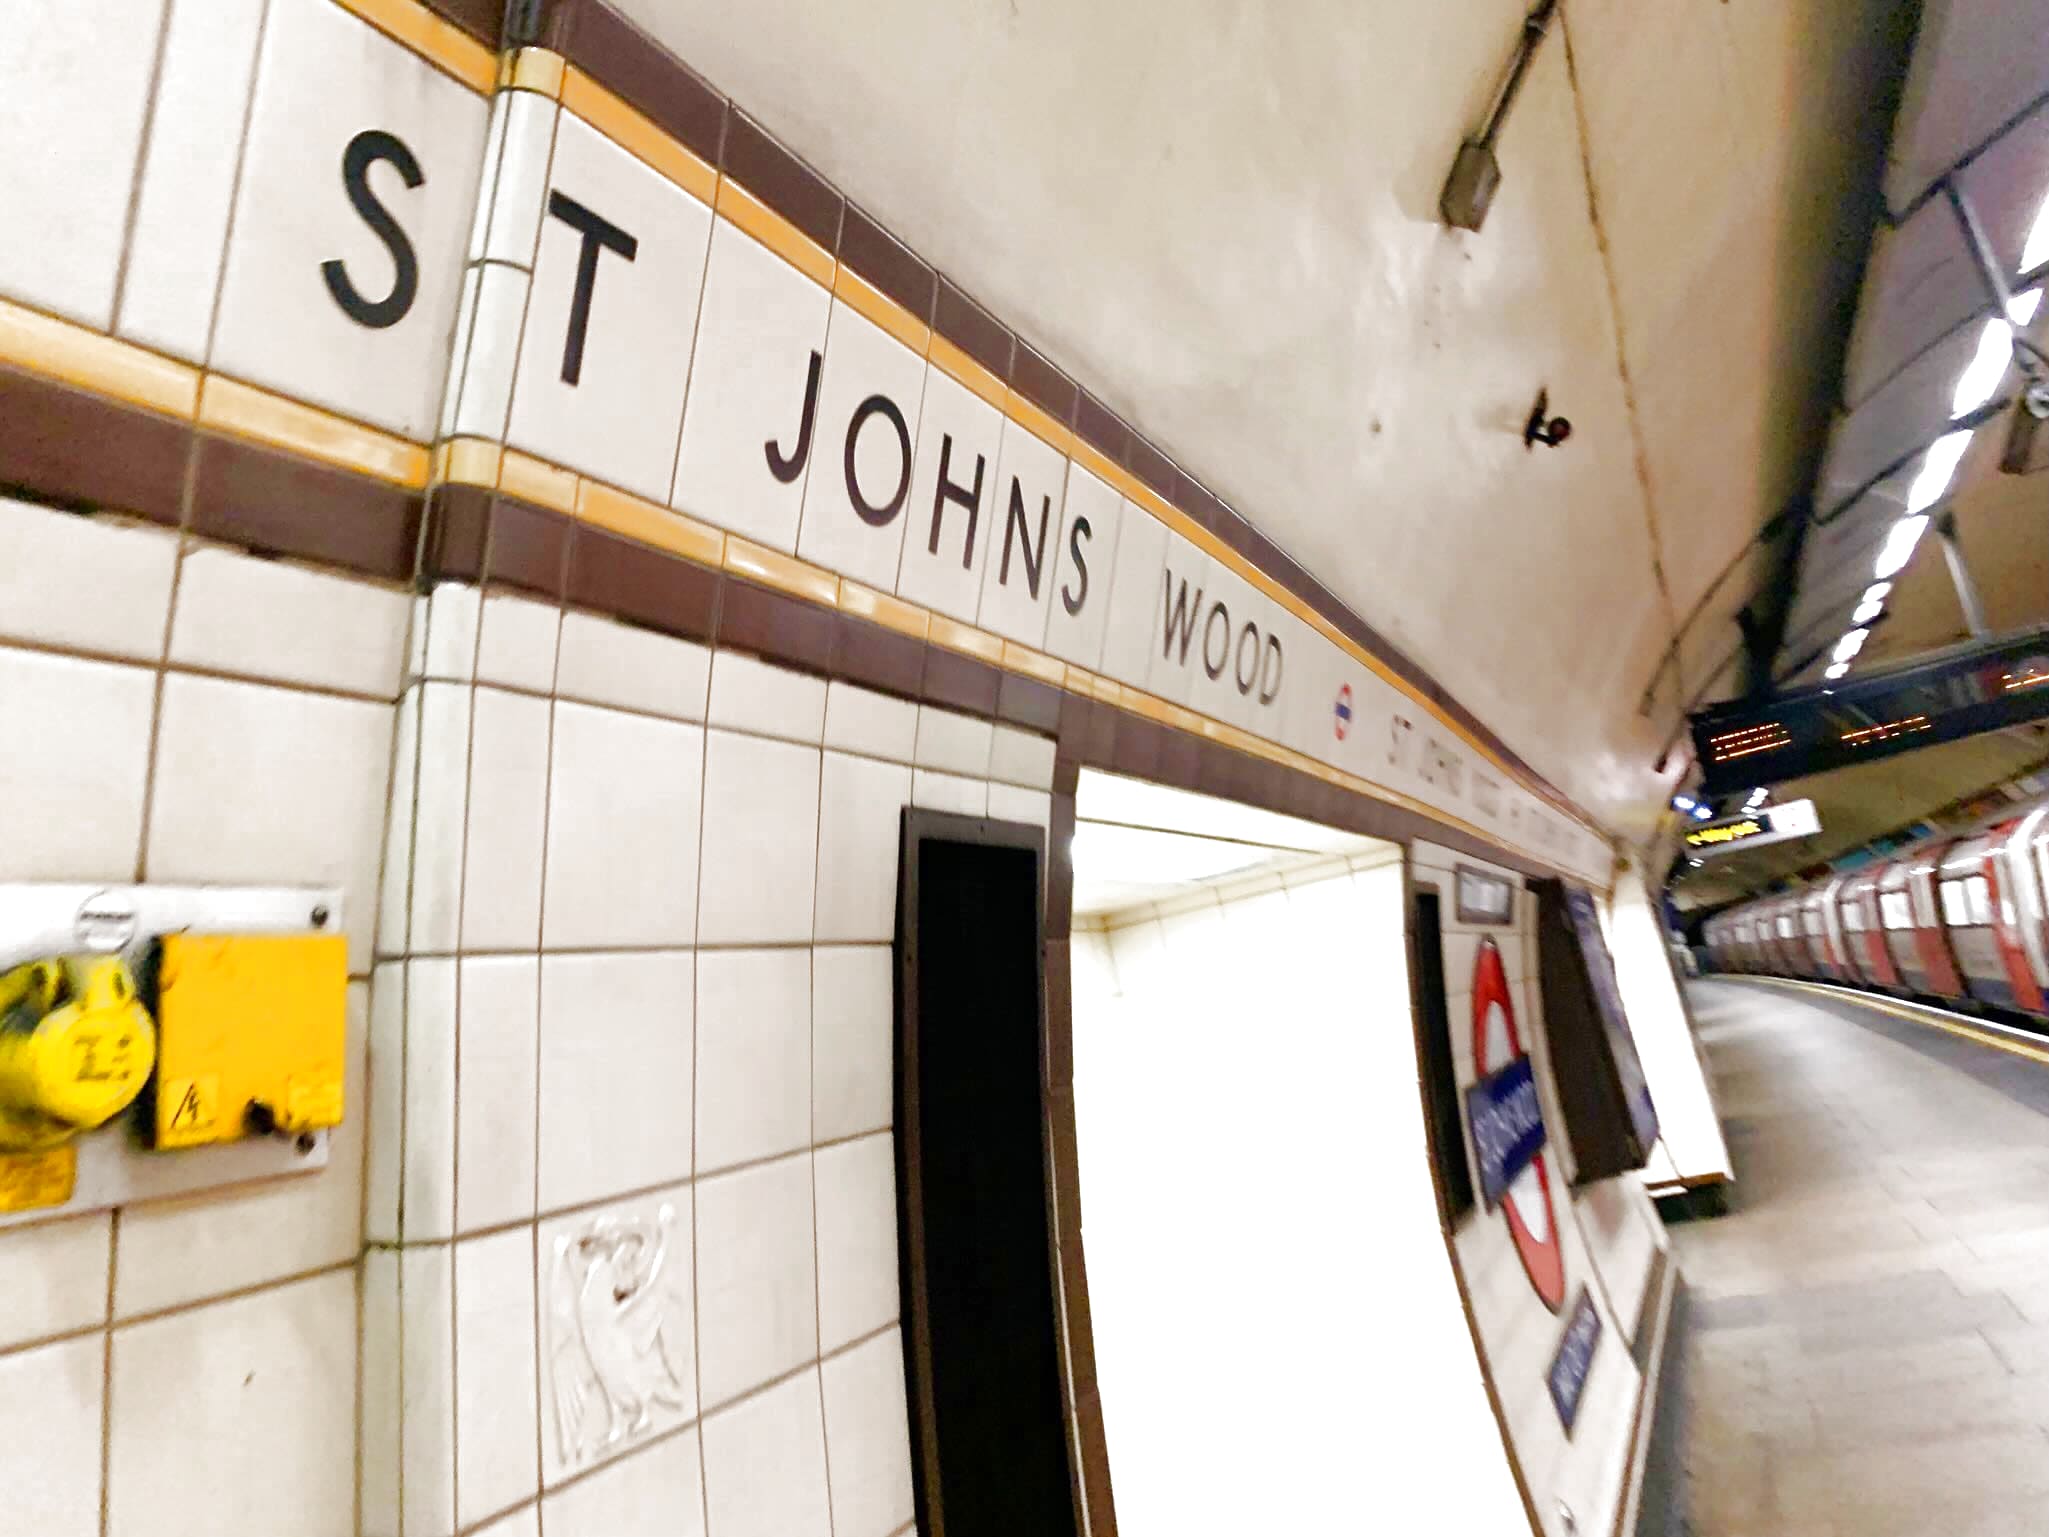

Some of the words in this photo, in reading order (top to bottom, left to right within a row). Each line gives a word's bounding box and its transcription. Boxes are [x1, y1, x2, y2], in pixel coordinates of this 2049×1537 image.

[320, 129, 638, 387] ST
[764, 349, 1092, 617] JOHNS
[1162, 567, 1283, 706] WOOD
